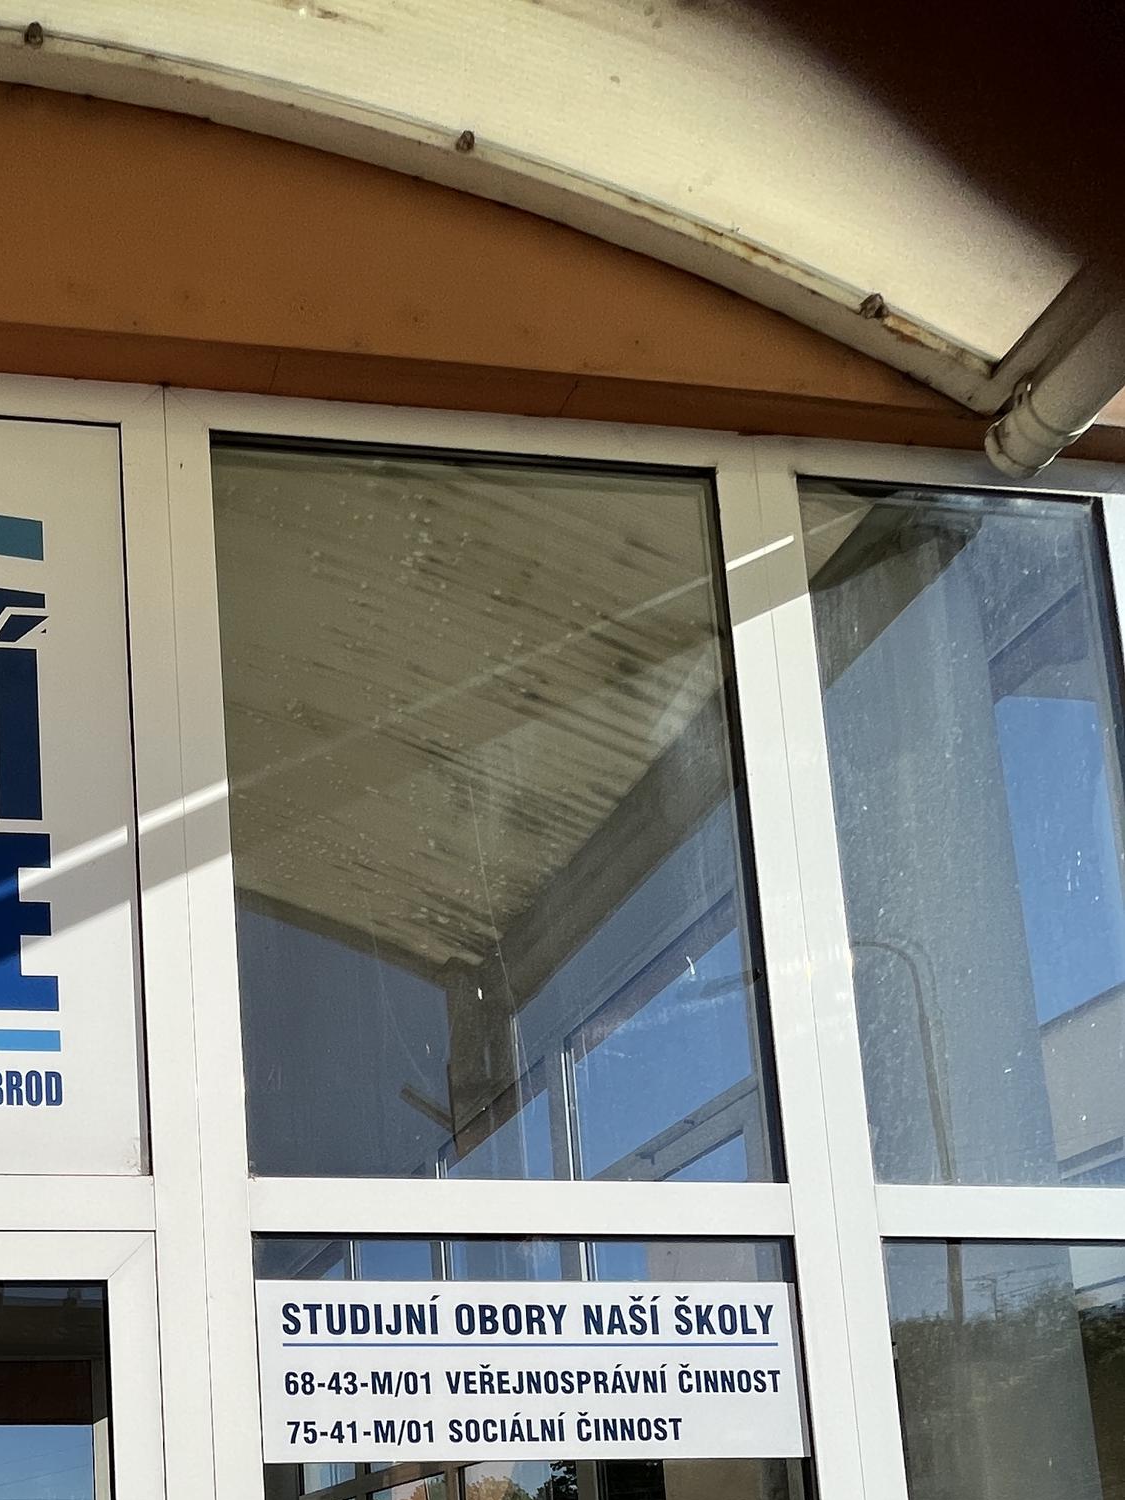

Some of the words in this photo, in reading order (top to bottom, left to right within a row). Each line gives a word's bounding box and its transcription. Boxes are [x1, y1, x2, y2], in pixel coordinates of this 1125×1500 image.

[282, 1296, 439, 1337] STUDIJNÍ
[454, 1303, 567, 1336] OBORY
[583, 1296, 660, 1335] NAŠÍ
[674, 1296, 775, 1336] ŠKOLY
[284, 1371, 432, 1398] 68-43-M/01
[446, 1363, 668, 1395] VEŘEJNOSPRÁVNÍ
[677, 1362, 781, 1394] ČINNOST
[286, 1420, 435, 1446] 75-41-M/01
[448, 1411, 566, 1443] SOCIÁLNÍ
[576, 1409, 683, 1442] ČINNOST
